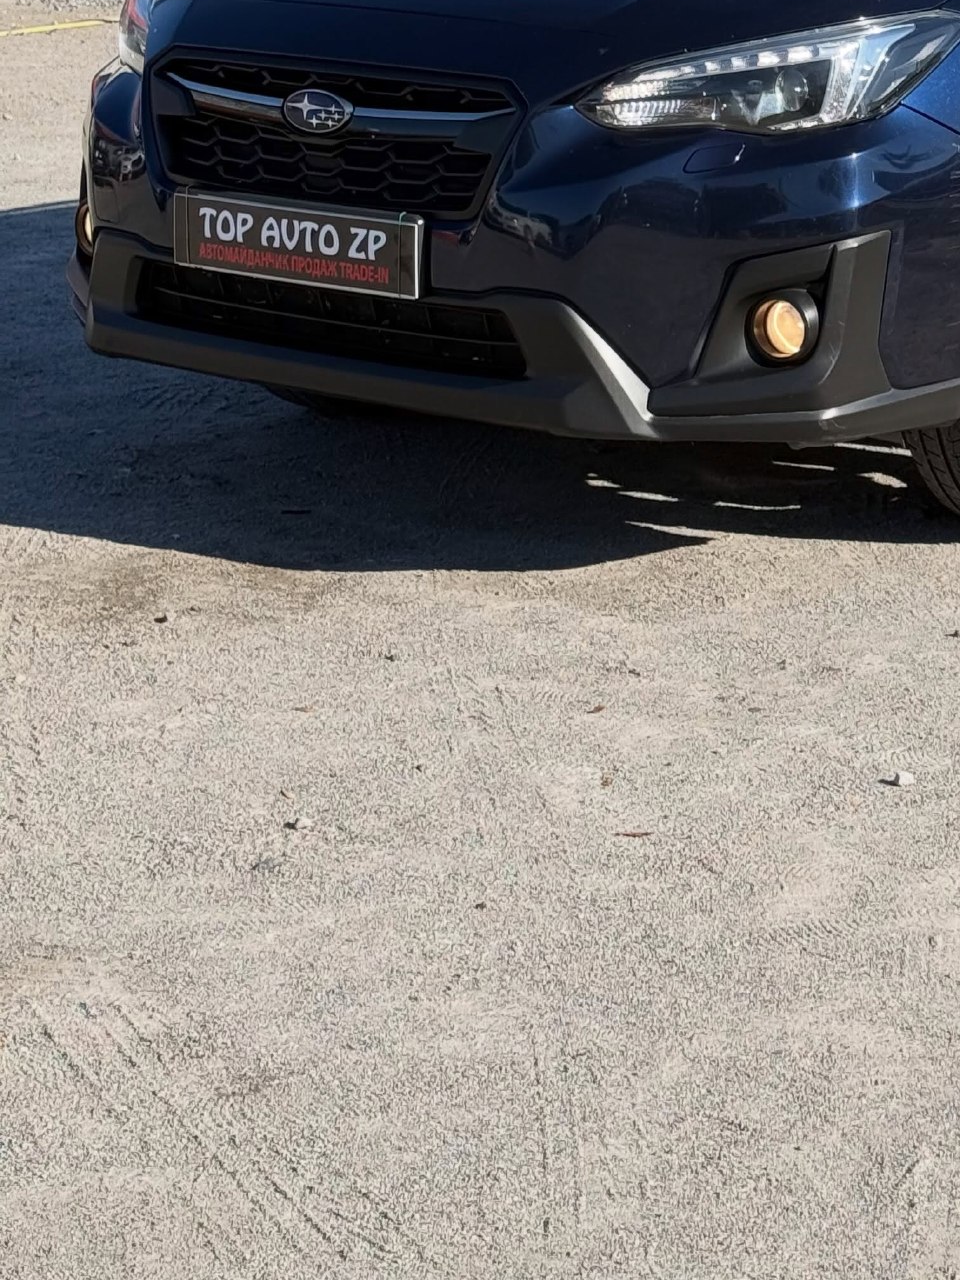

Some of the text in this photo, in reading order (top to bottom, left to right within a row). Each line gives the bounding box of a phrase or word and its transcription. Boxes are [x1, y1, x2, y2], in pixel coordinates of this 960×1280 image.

[198, 207, 387, 261] TOP AVTO ZP
[198, 242, 389, 285] АВТОМАЙДАНЧИК ПРОДАЖ TRADE-IN
